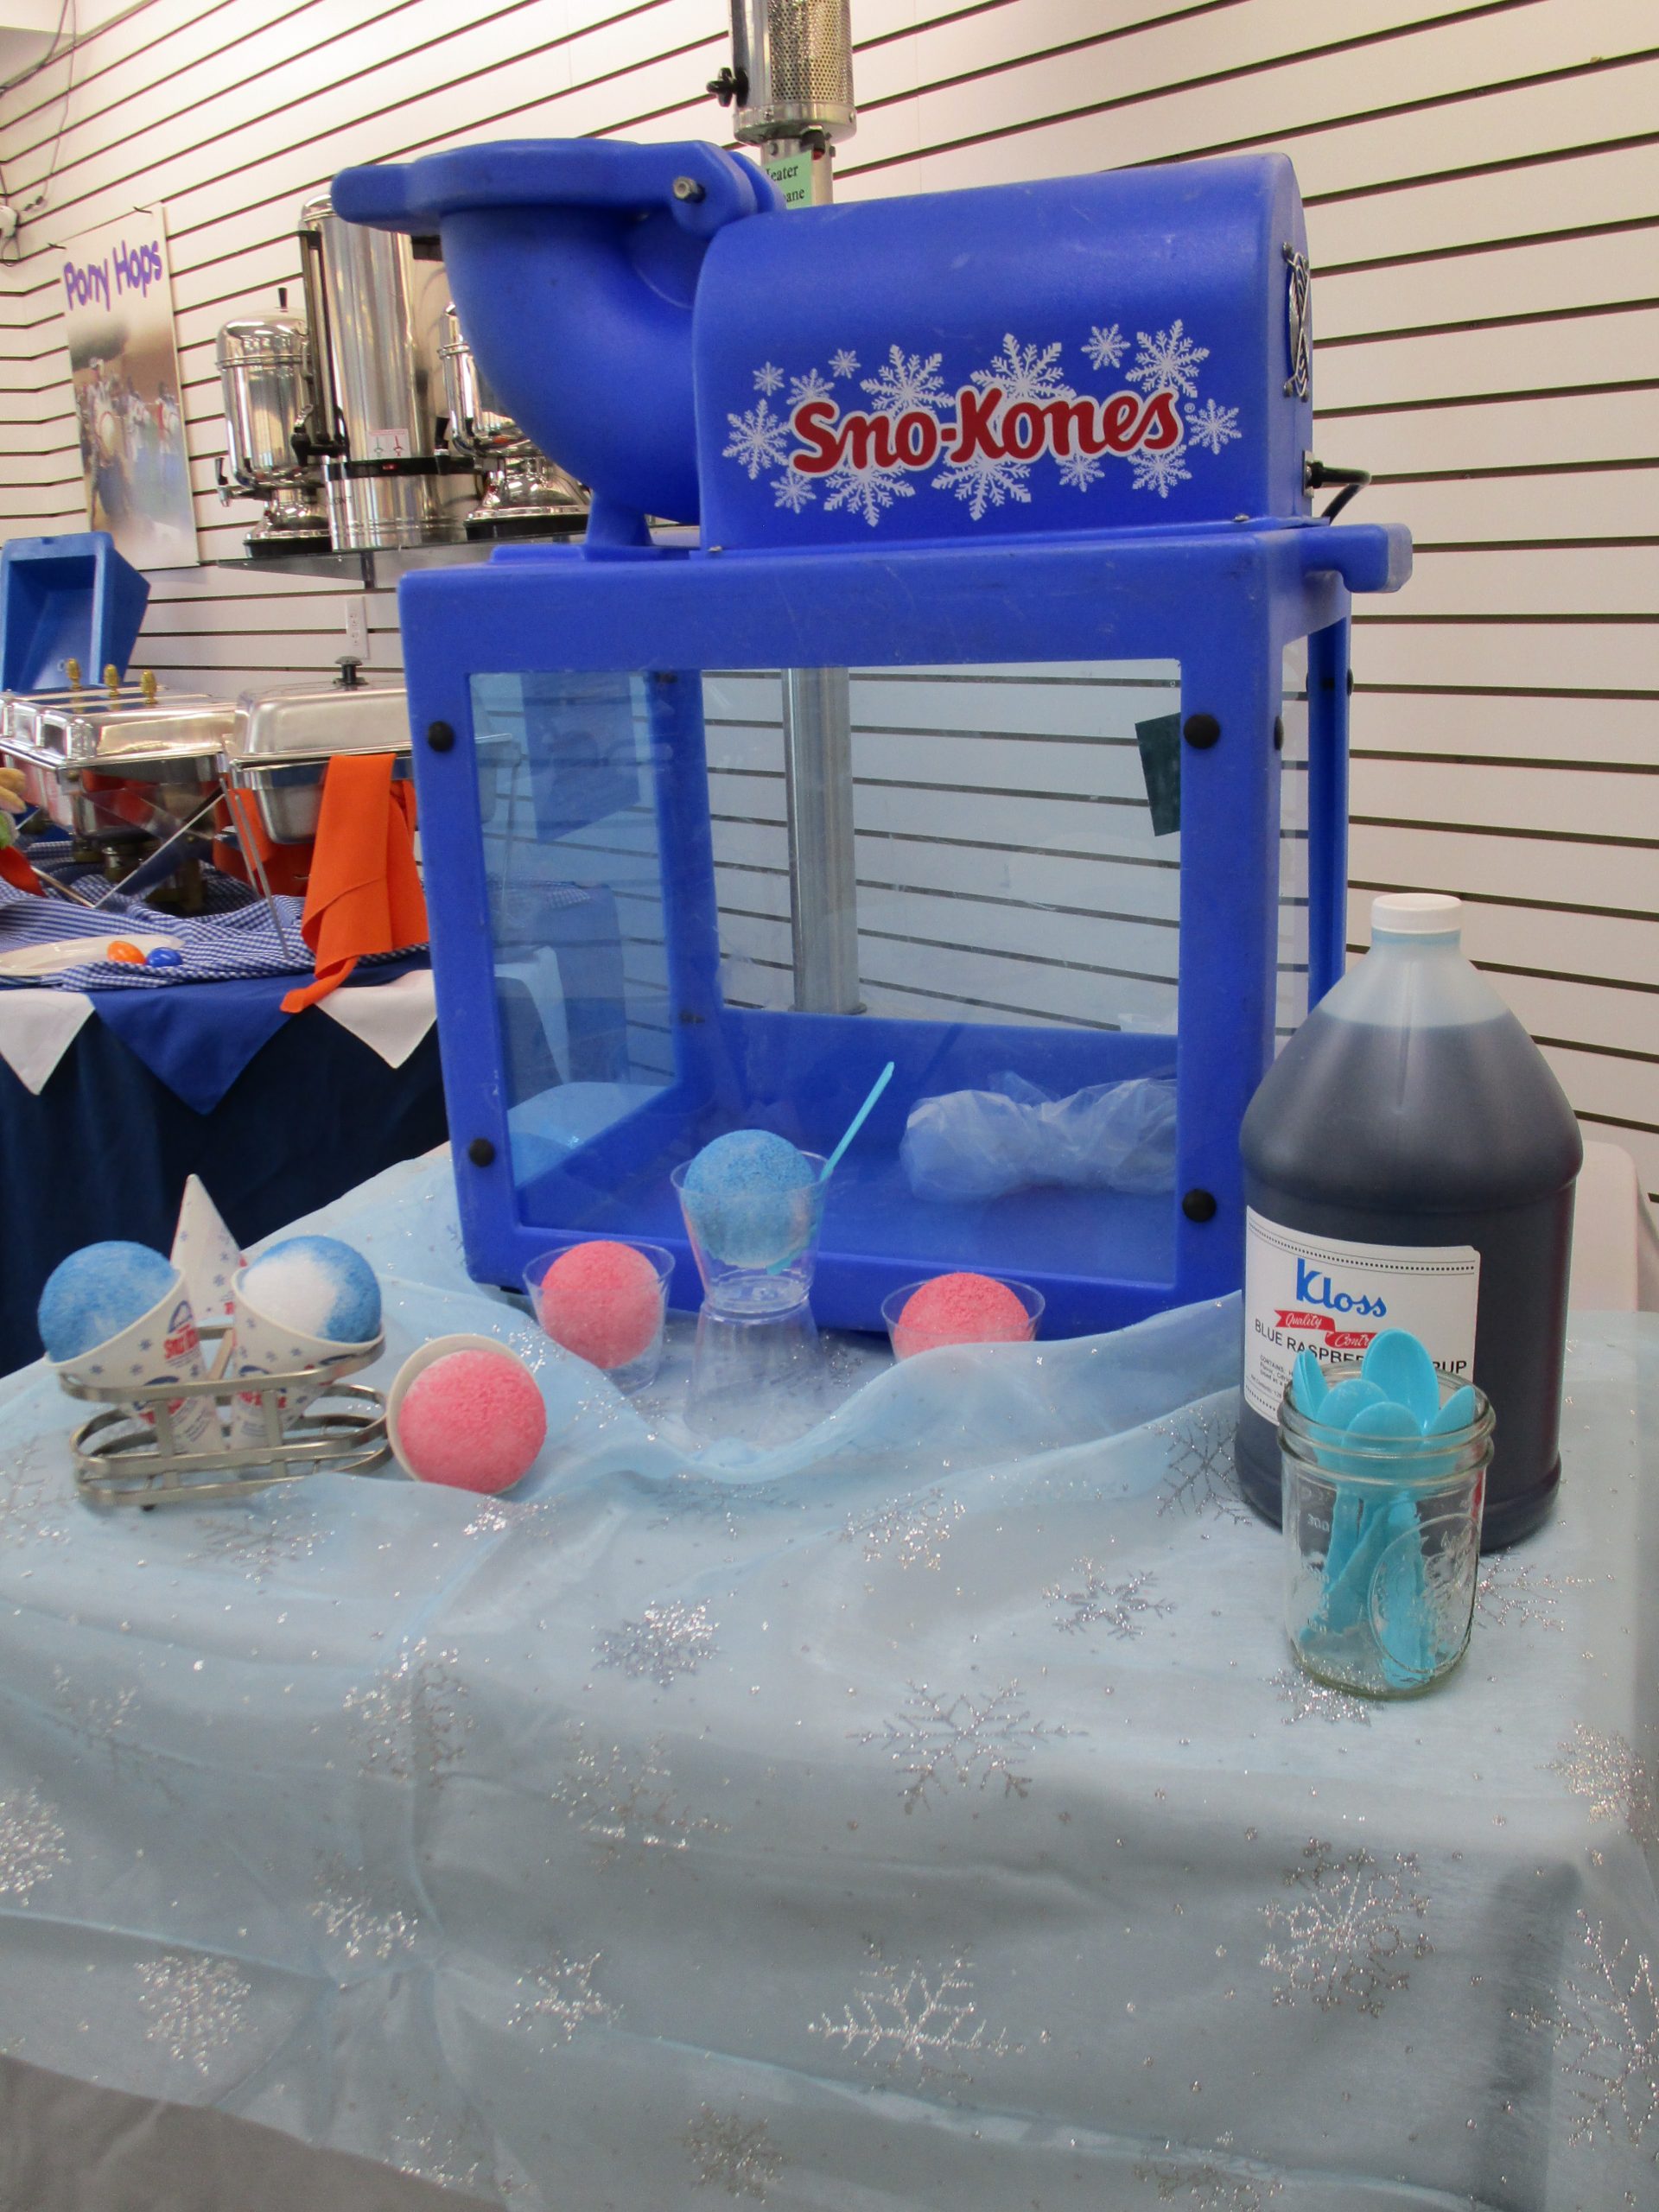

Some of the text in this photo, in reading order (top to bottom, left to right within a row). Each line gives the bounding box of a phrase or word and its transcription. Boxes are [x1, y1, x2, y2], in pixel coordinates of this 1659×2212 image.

[785, 188, 805, 202] ane
[63, 239, 162, 312] Pony Hops
[793, 387, 1179, 474] Sno-Kones
[1296, 1257, 1387, 1318] Kloss
[1255, 1319, 1283, 1346] BLUE
[1286, 1313, 1322, 1329] Quality
[1334, 1333, 1370, 1348] Contr
